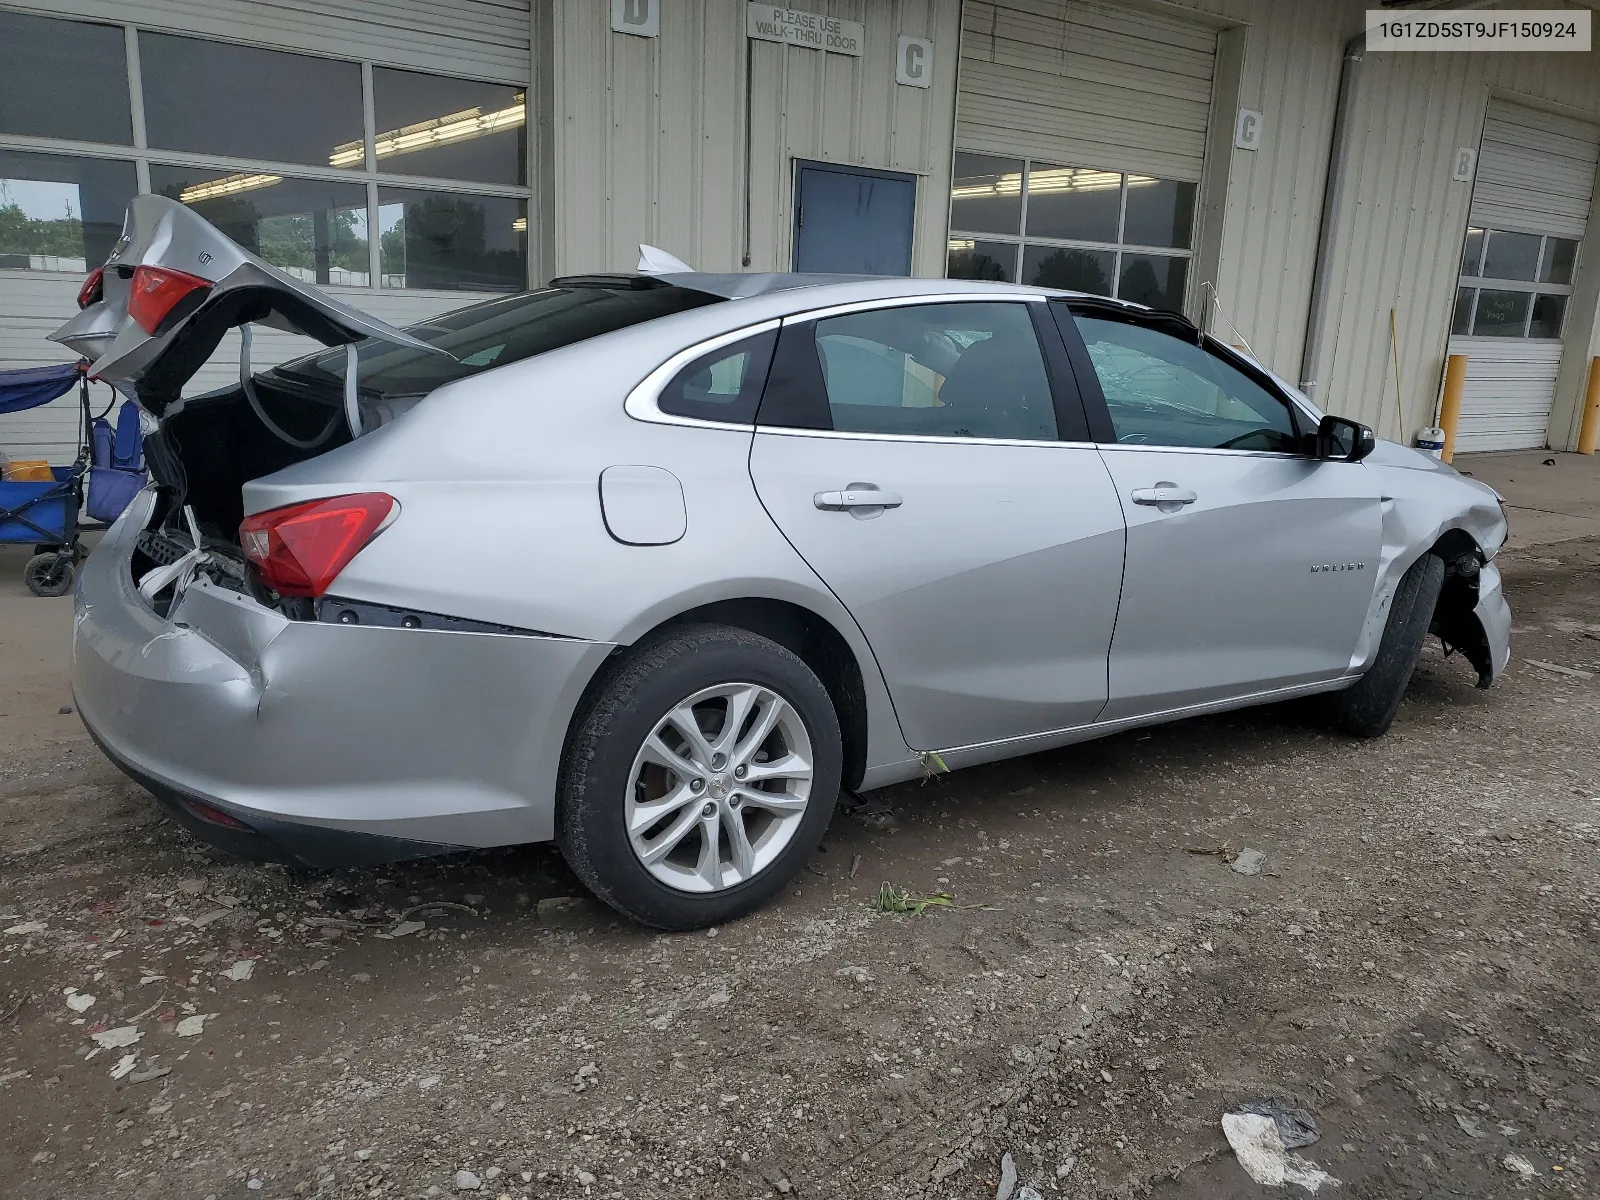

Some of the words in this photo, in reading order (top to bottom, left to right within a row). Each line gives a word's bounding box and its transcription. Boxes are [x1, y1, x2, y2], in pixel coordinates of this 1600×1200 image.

[756, 20, 822, 43] WALK-THRU
[826, 34, 857, 50] DOOR
[773, 10, 815, 29] PLEASE
[820, 17, 841, 34] USE
[906, 43, 924, 78] C
[1242, 114, 1256, 142] C
[1457, 152, 1471, 175] B
